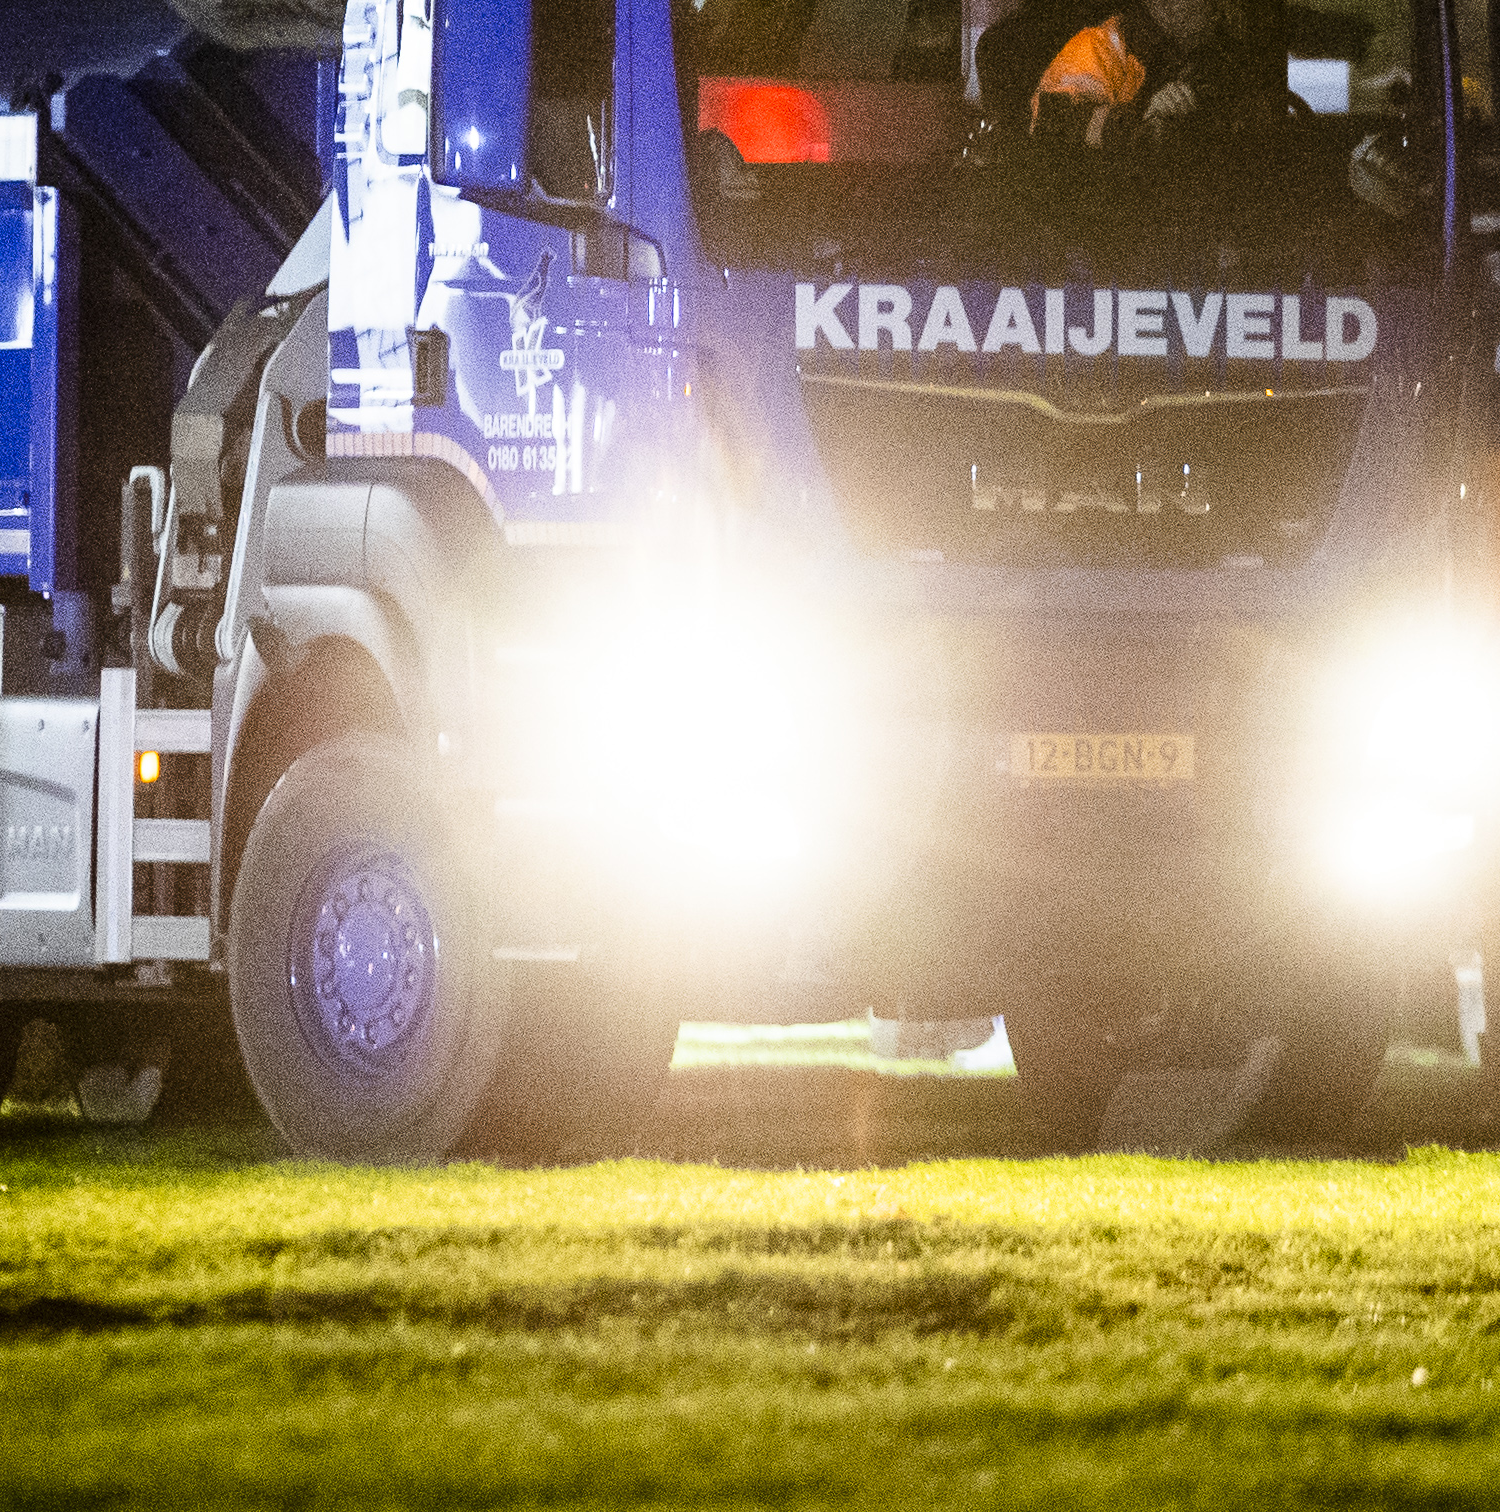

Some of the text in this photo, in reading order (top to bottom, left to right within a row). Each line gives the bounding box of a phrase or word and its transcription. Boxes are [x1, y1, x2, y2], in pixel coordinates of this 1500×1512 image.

[795, 283, 1379, 363] KRAAIJEVELD
[1025, 738, 1181, 775] 12-BGN-9
[7, 824, 71, 861] MAN
